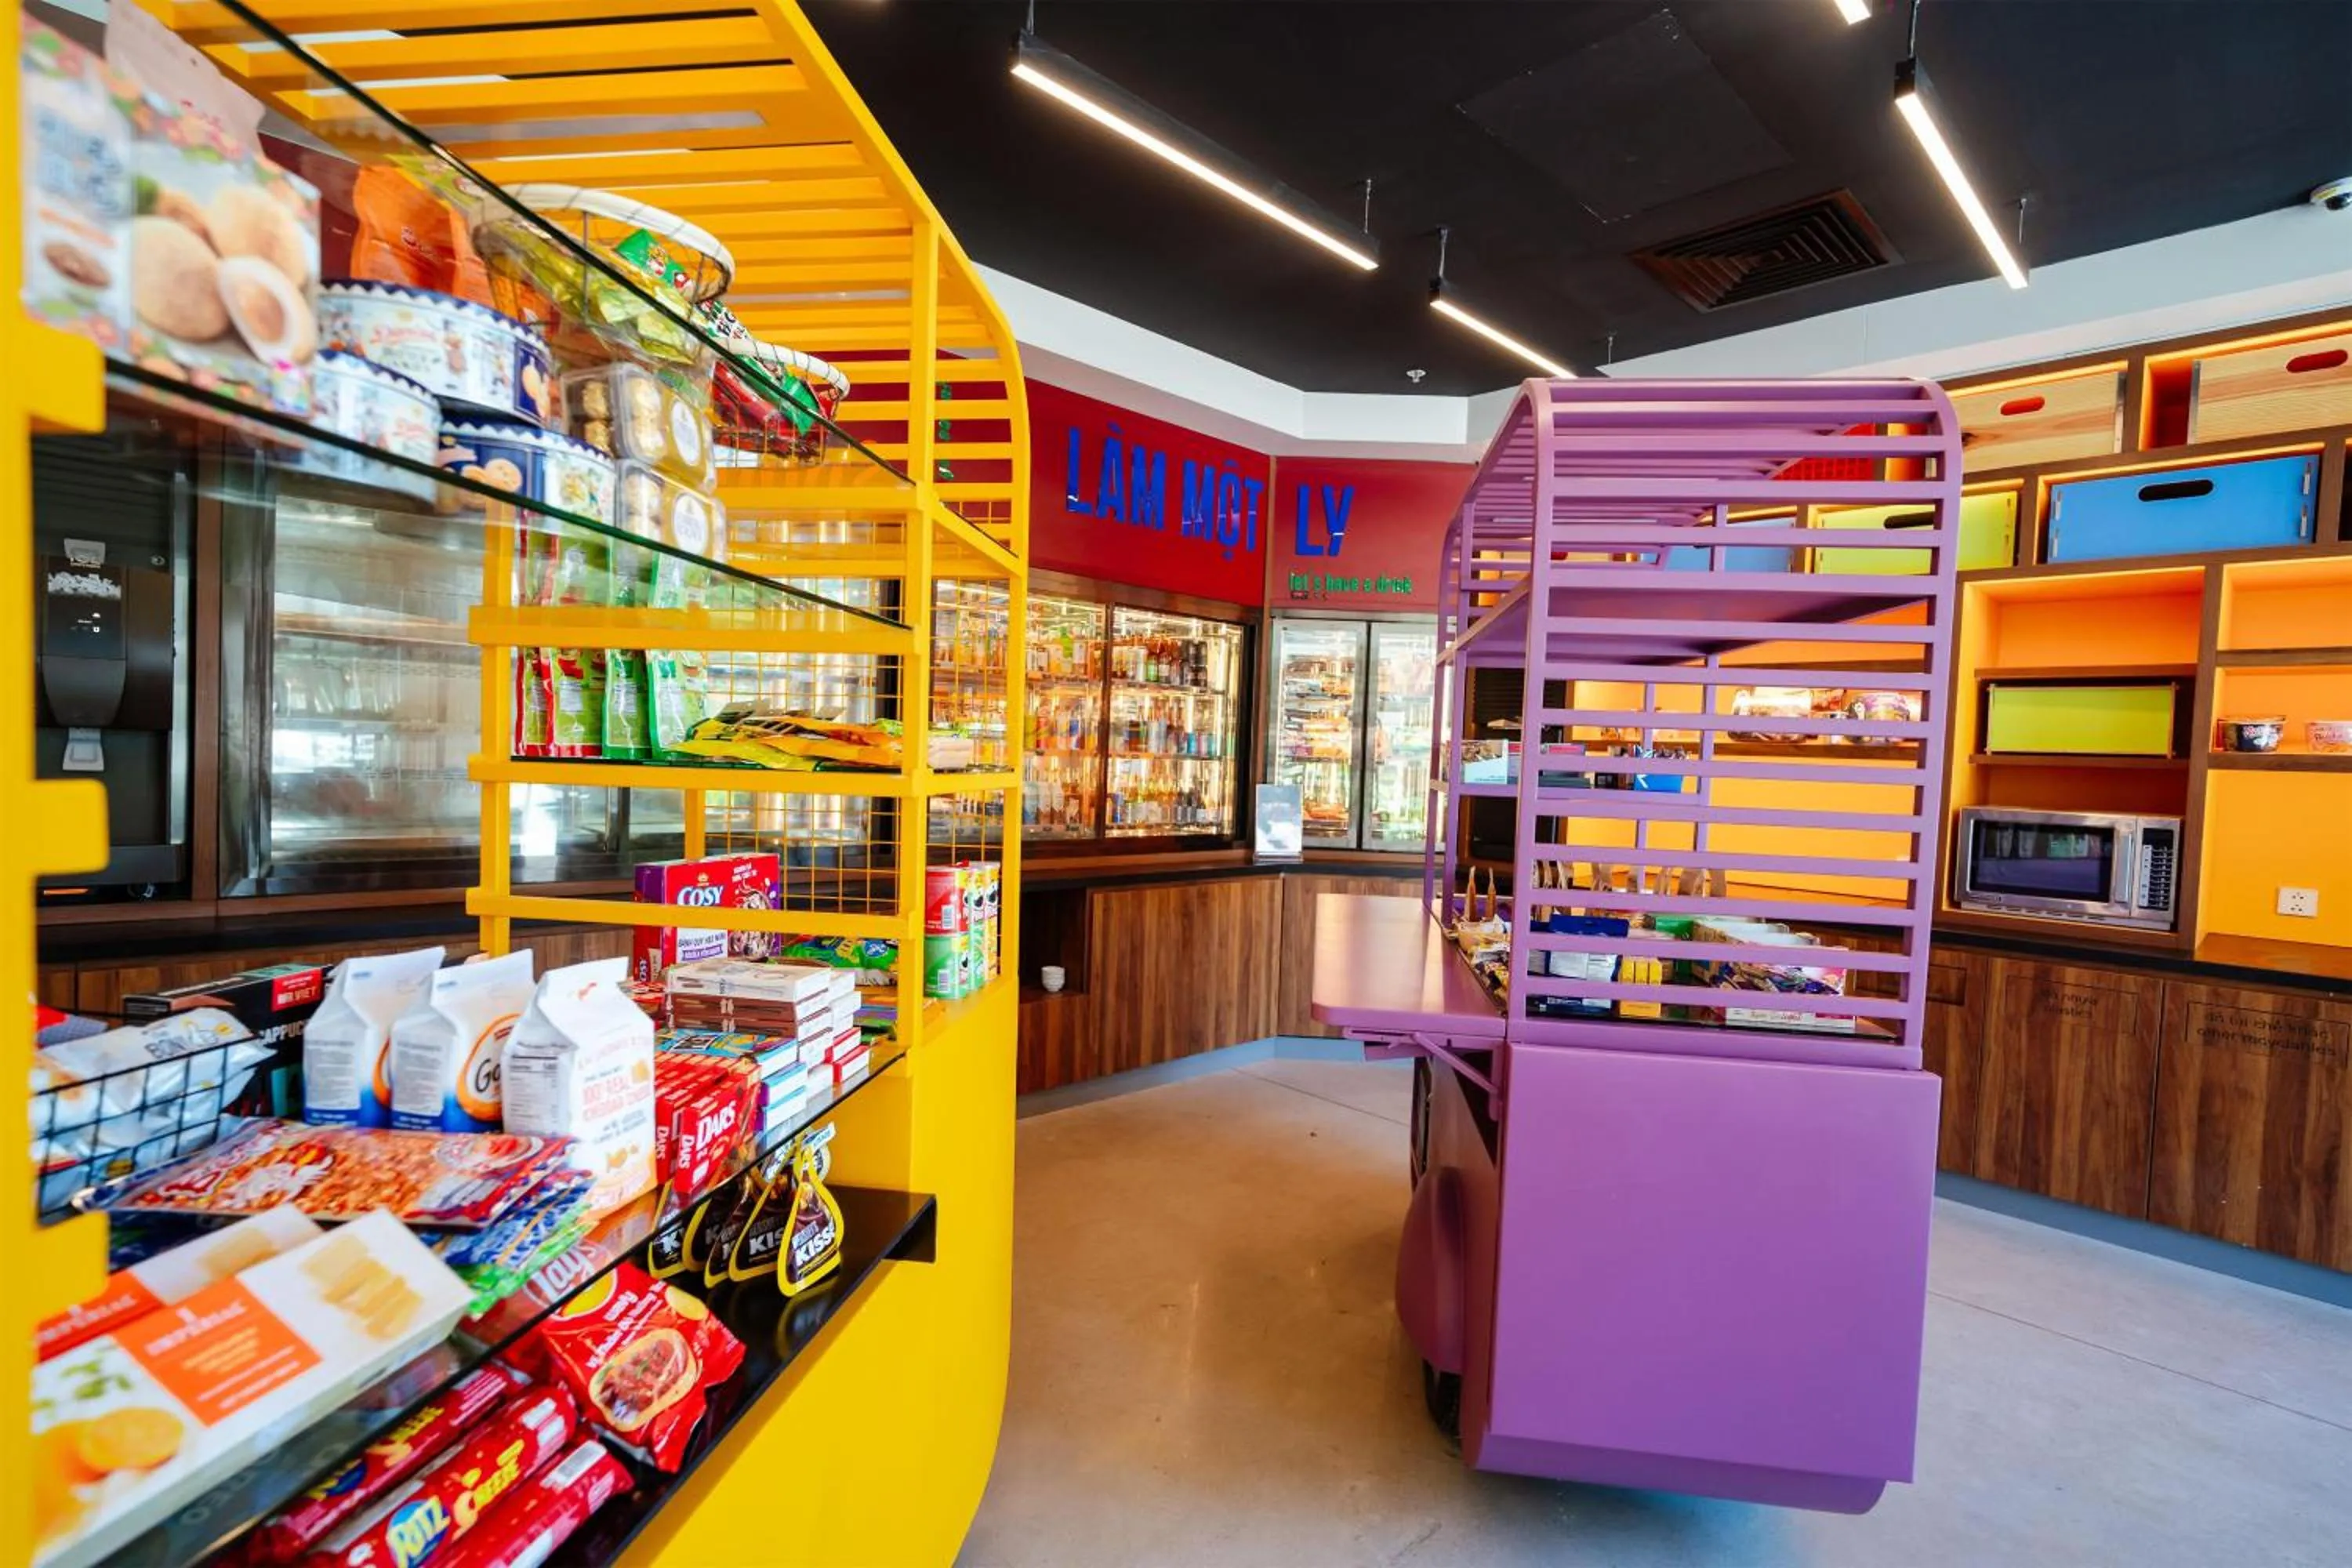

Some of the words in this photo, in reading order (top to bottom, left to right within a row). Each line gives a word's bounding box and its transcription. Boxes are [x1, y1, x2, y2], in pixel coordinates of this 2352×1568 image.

[1067, 422, 1167, 531] LÀM
[1181, 459, 1264, 561] MỘT
[1295, 485, 1355, 557] LY
[1325, 573, 1359, 593] have
[1363, 577, 1372, 593] a
[677, 885, 724, 906] COSY
[679, 1134, 695, 1169] DARS
[696, 1100, 737, 1152] DARS
[793, 1218, 836, 1269] KISS
[386, 1494, 451, 1568] RITZ
